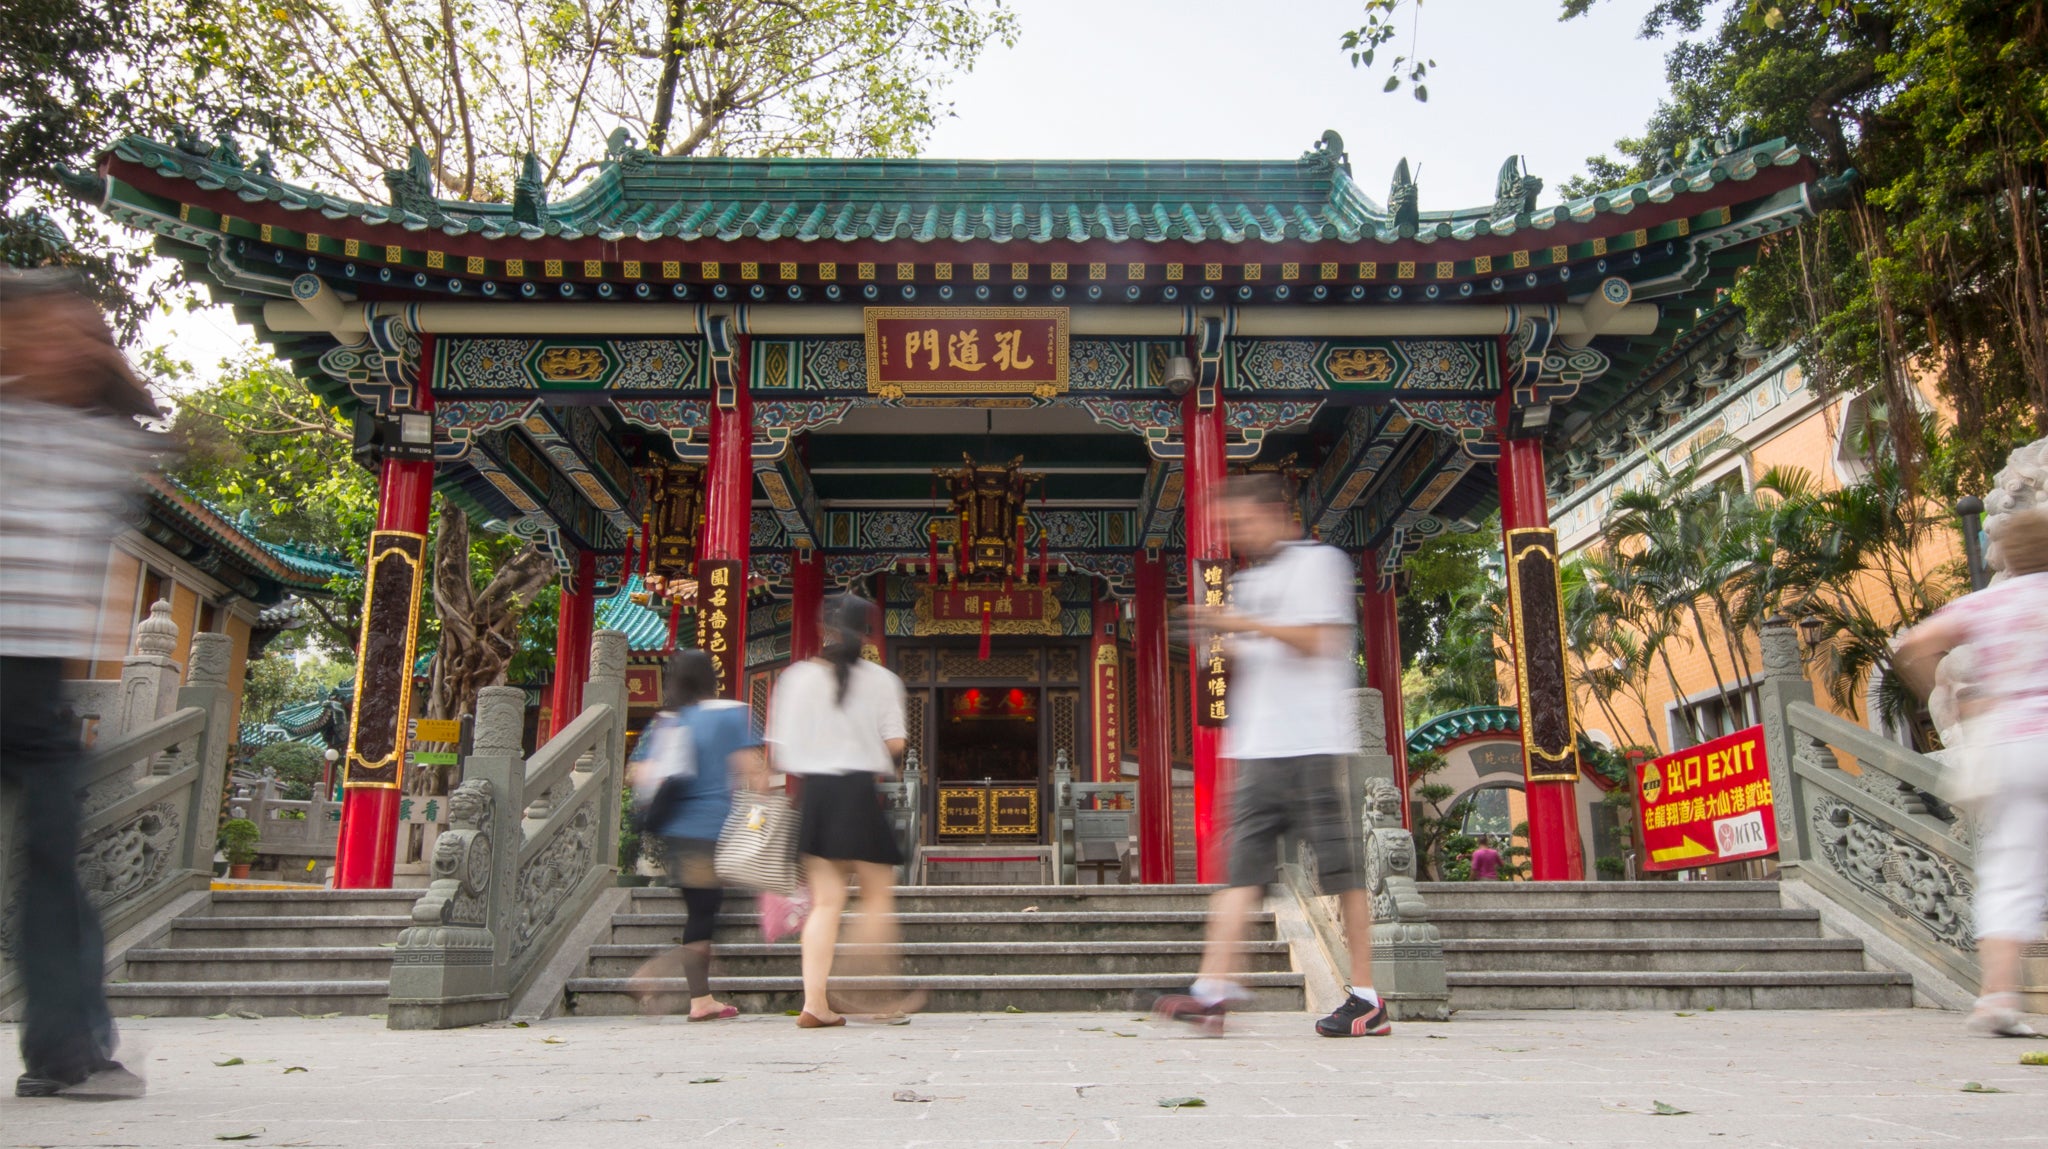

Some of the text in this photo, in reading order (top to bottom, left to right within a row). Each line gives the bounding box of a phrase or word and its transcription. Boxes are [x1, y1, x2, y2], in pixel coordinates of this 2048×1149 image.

[905, 328, 1034, 371] 孔道門
[409, 447, 431, 455] PHILIPS
[1667, 740, 1756, 795] 出口 EXIT
[1734, 821, 1763, 846] MTR
